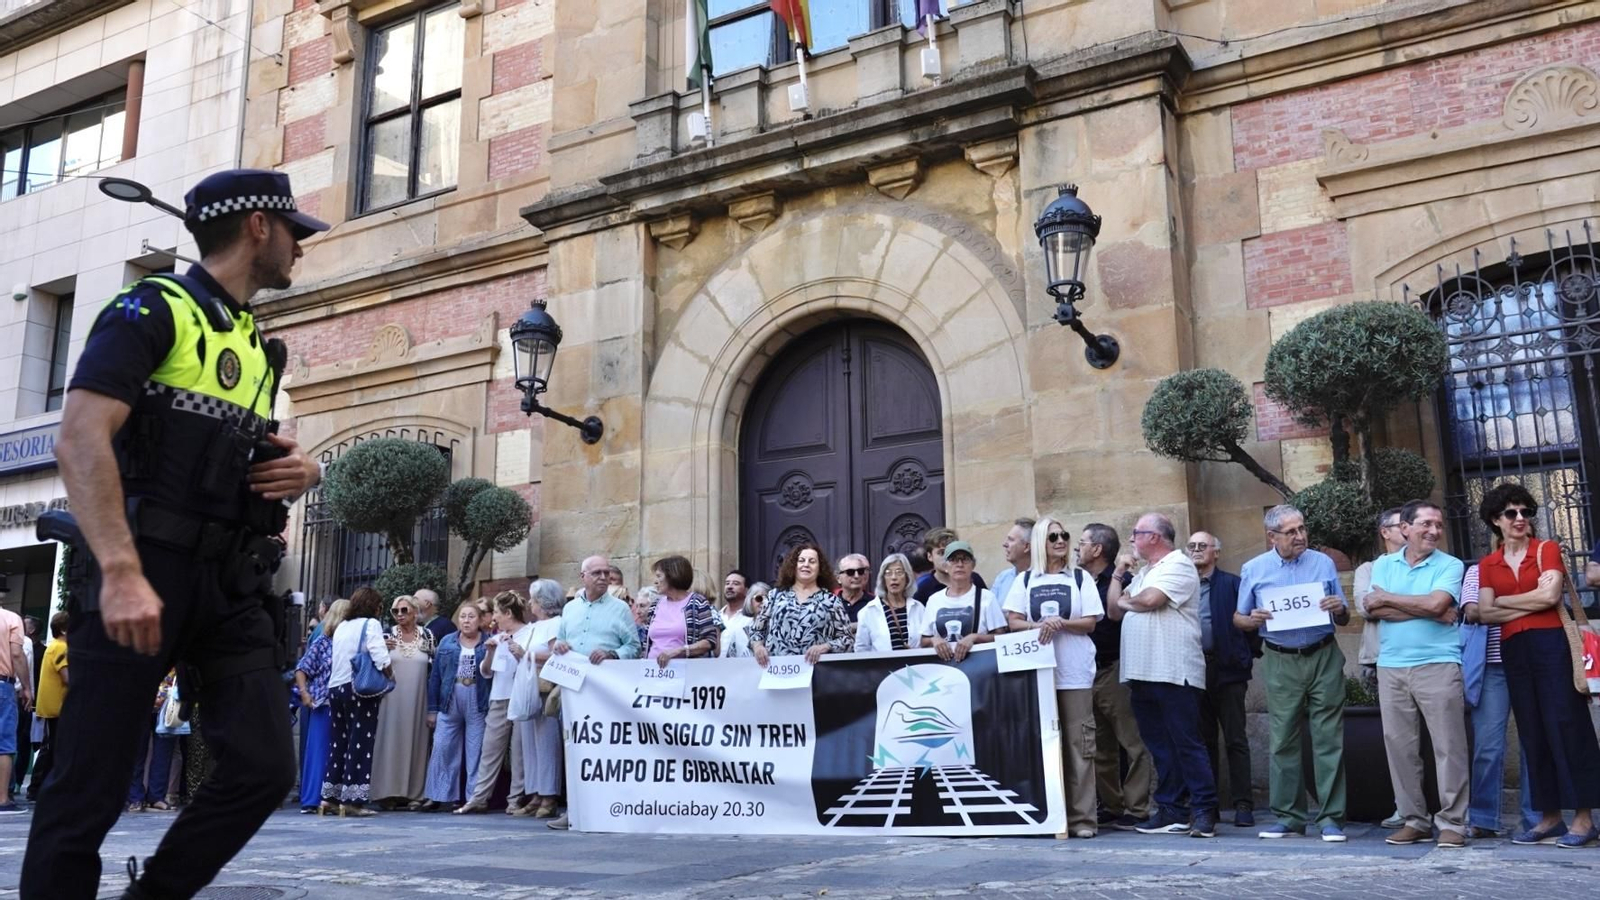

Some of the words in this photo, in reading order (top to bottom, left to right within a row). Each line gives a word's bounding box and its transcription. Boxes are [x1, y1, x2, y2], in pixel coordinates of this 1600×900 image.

[1269, 595, 1311, 613] 1.365
[1002, 640, 1039, 656] 1.365
[644, 668, 675, 679] 21.840
[767, 664, 800, 675] 40.950
[609, 721, 632, 745] DE
[637, 722, 660, 745] UN
[662, 722, 715, 747] SIGLO
[720, 724, 752, 748] SIN
[757, 723, 806, 748] TREN
[580, 758, 647, 783] CAMPO
[653, 759, 677, 783] DE
[682, 759, 776, 785] GIBRALTAR
[609, 800, 719, 821] @ndaluciabay
[722, 801, 765, 817] 20.30
